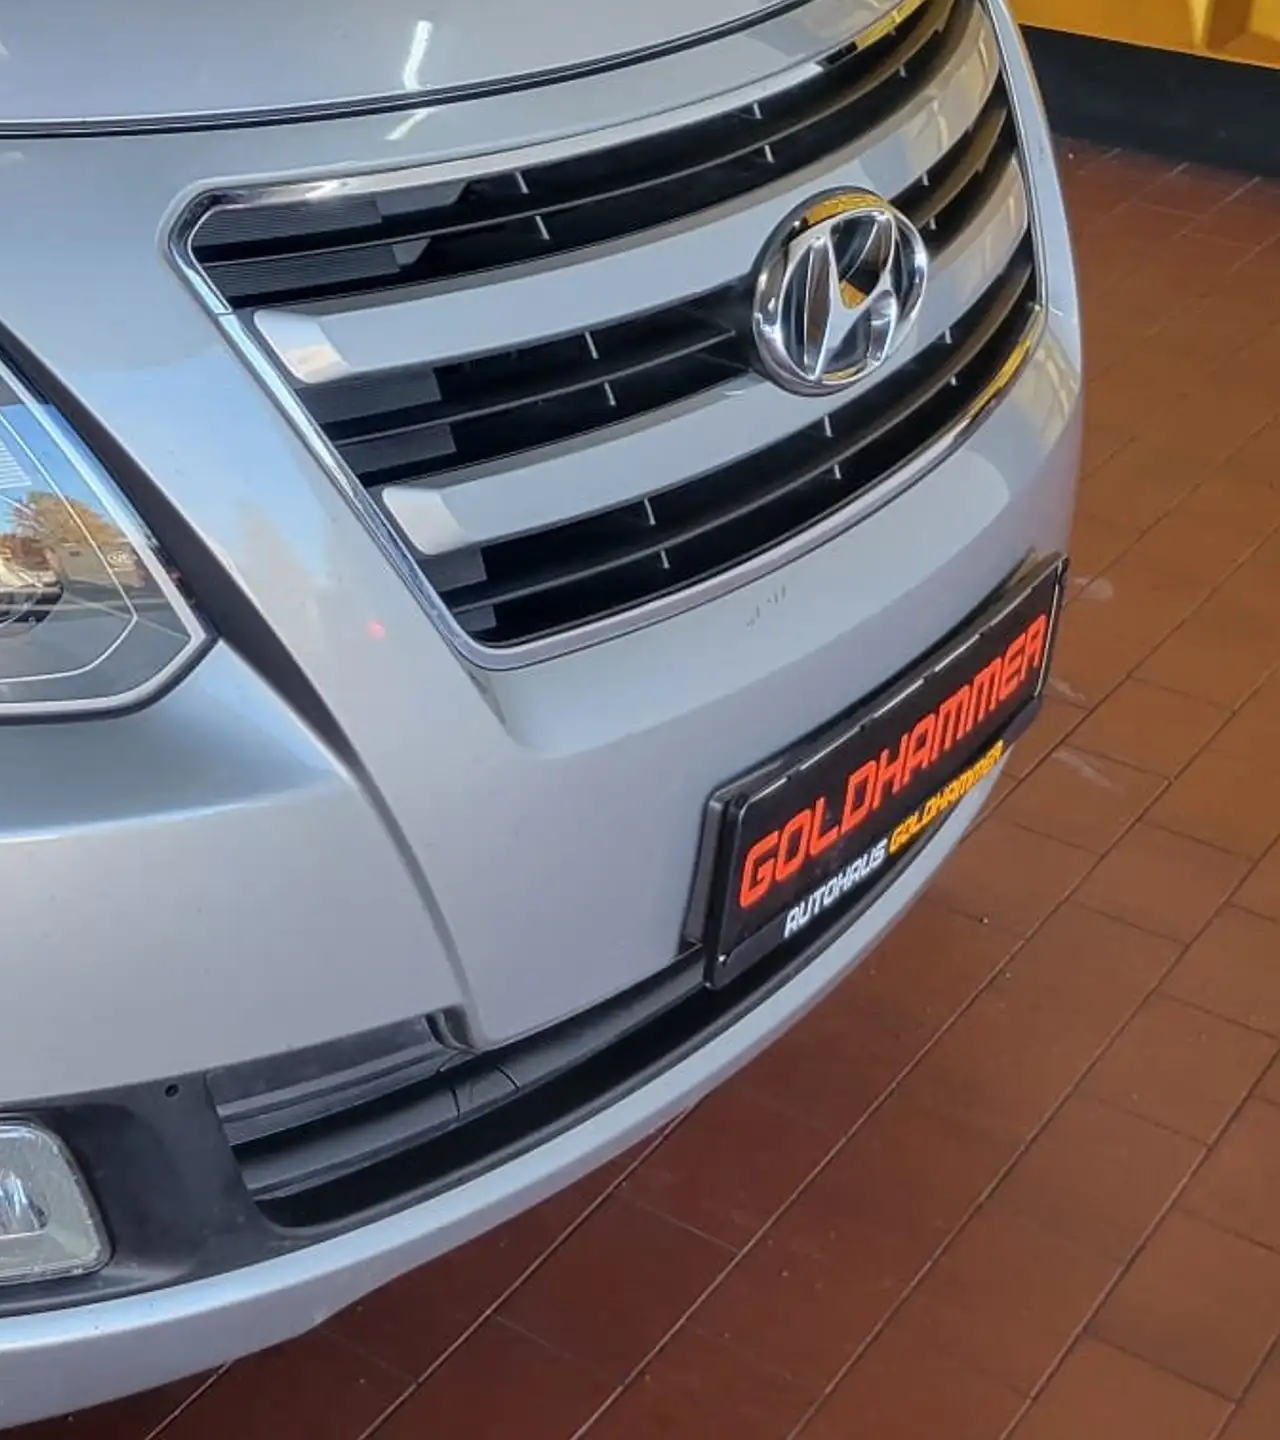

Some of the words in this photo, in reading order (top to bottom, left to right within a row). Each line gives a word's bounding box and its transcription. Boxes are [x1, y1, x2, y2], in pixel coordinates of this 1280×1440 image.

[738, 612, 1048, 909] GOLDHAMMER
[783, 837, 889, 939] AUTOHAUS
[888, 739, 1005, 855] GOLDHAMMER
